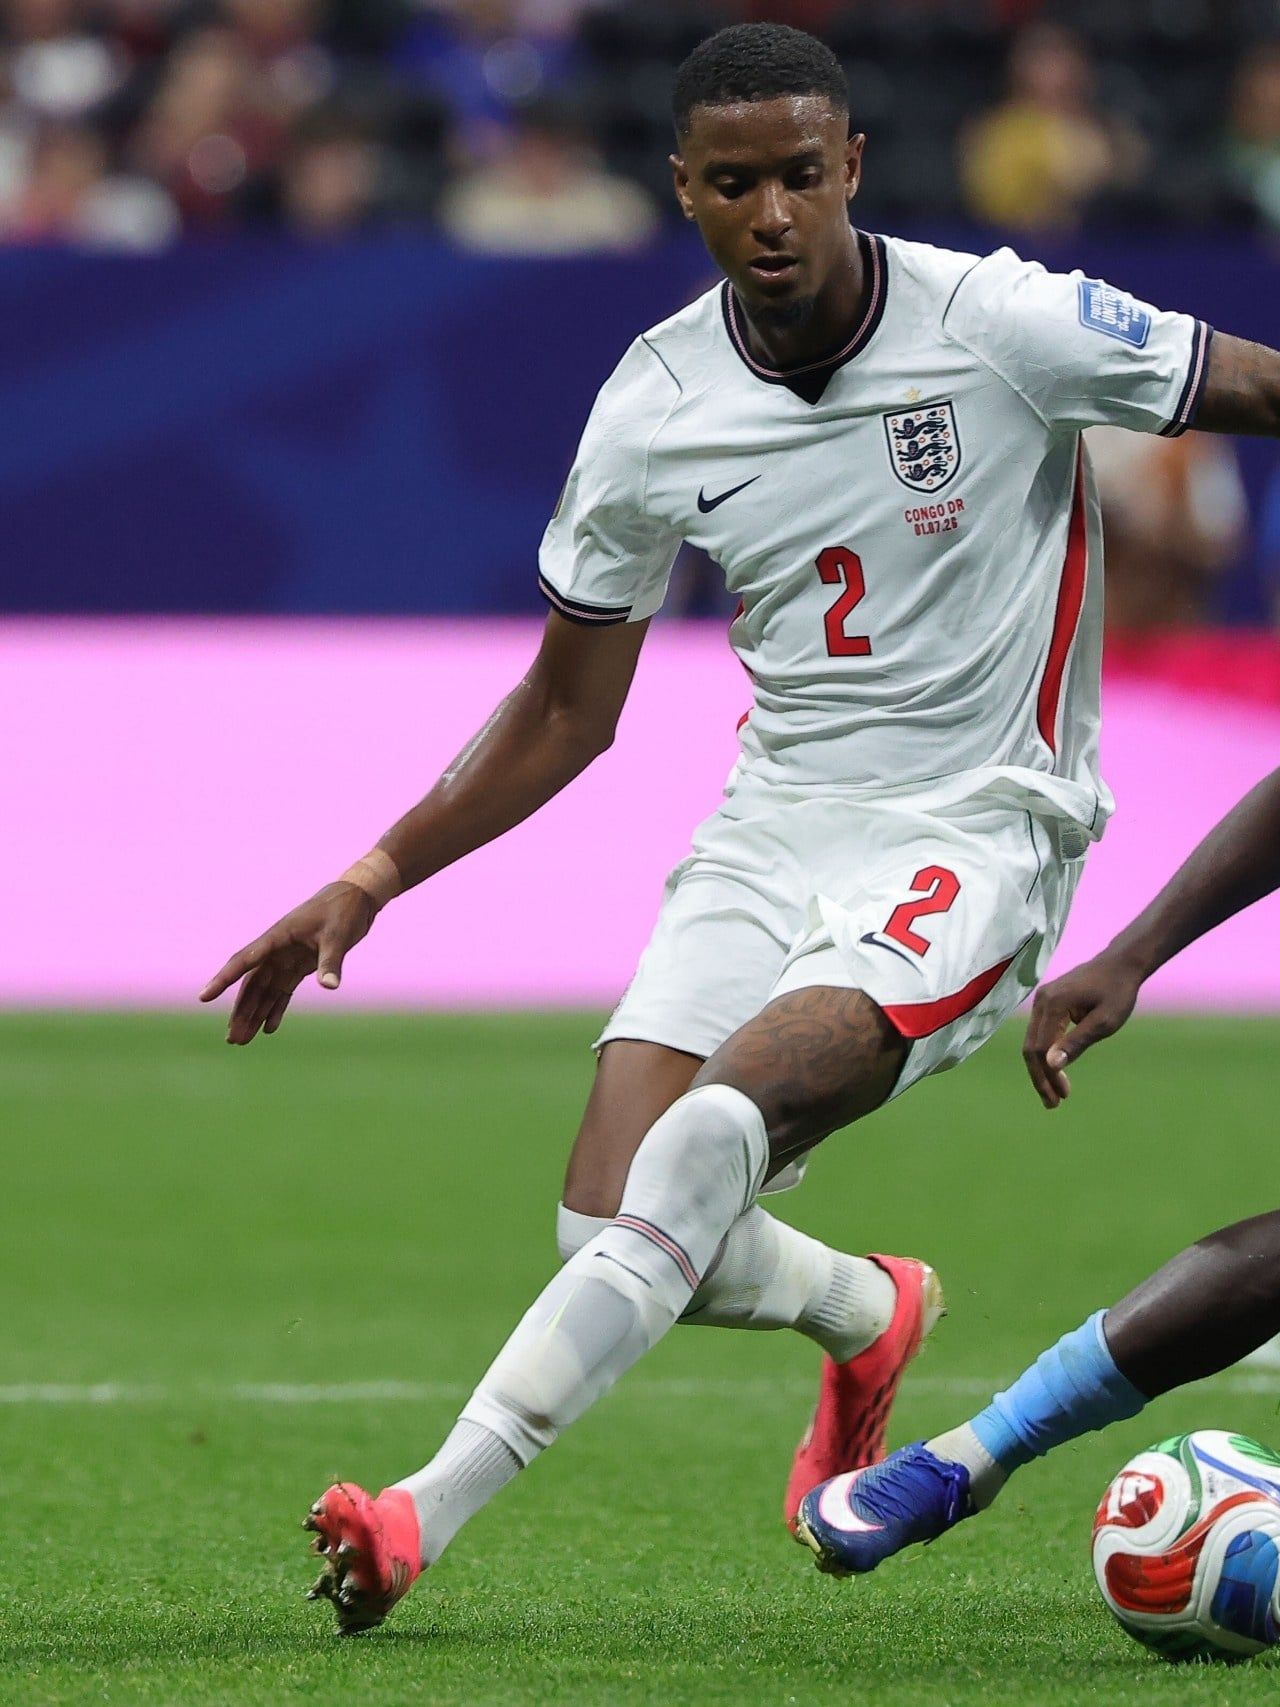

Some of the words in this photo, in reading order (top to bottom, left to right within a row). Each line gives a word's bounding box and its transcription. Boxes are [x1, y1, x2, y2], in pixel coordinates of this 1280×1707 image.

[905, 503, 945, 523] CONGO
[947, 498, 965, 514] DR
[914, 516, 958, 537] 01.07.26
[815, 546, 872, 658] 2
[882, 864, 962, 959] 2
